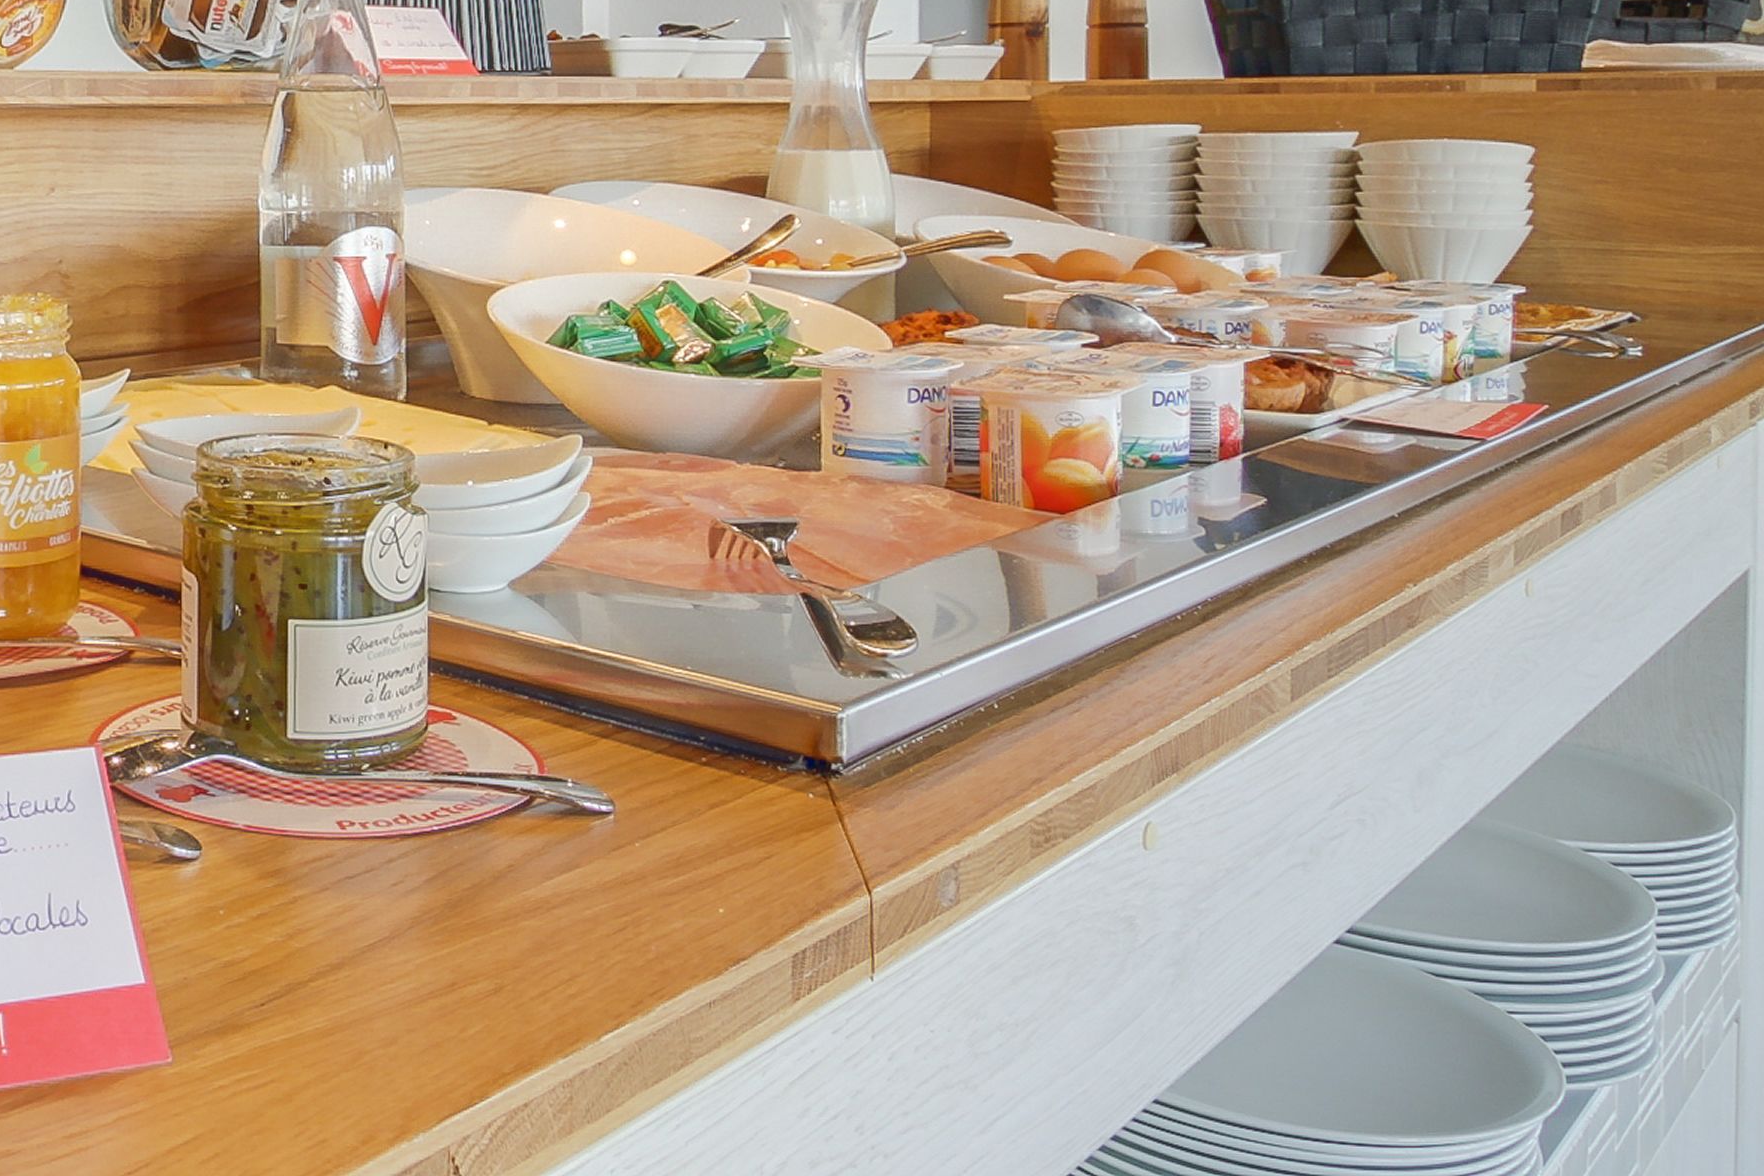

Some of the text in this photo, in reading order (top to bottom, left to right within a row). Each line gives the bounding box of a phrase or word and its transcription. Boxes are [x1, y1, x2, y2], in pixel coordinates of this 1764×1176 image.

[332, 253, 397, 347] V
[9, 500, 72, 529] Charlotte
[335, 667, 374, 687] Kiwi
[364, 689, 375, 704] à
[379, 682, 394, 702] la
[329, 713, 355, 725] Kiwi
